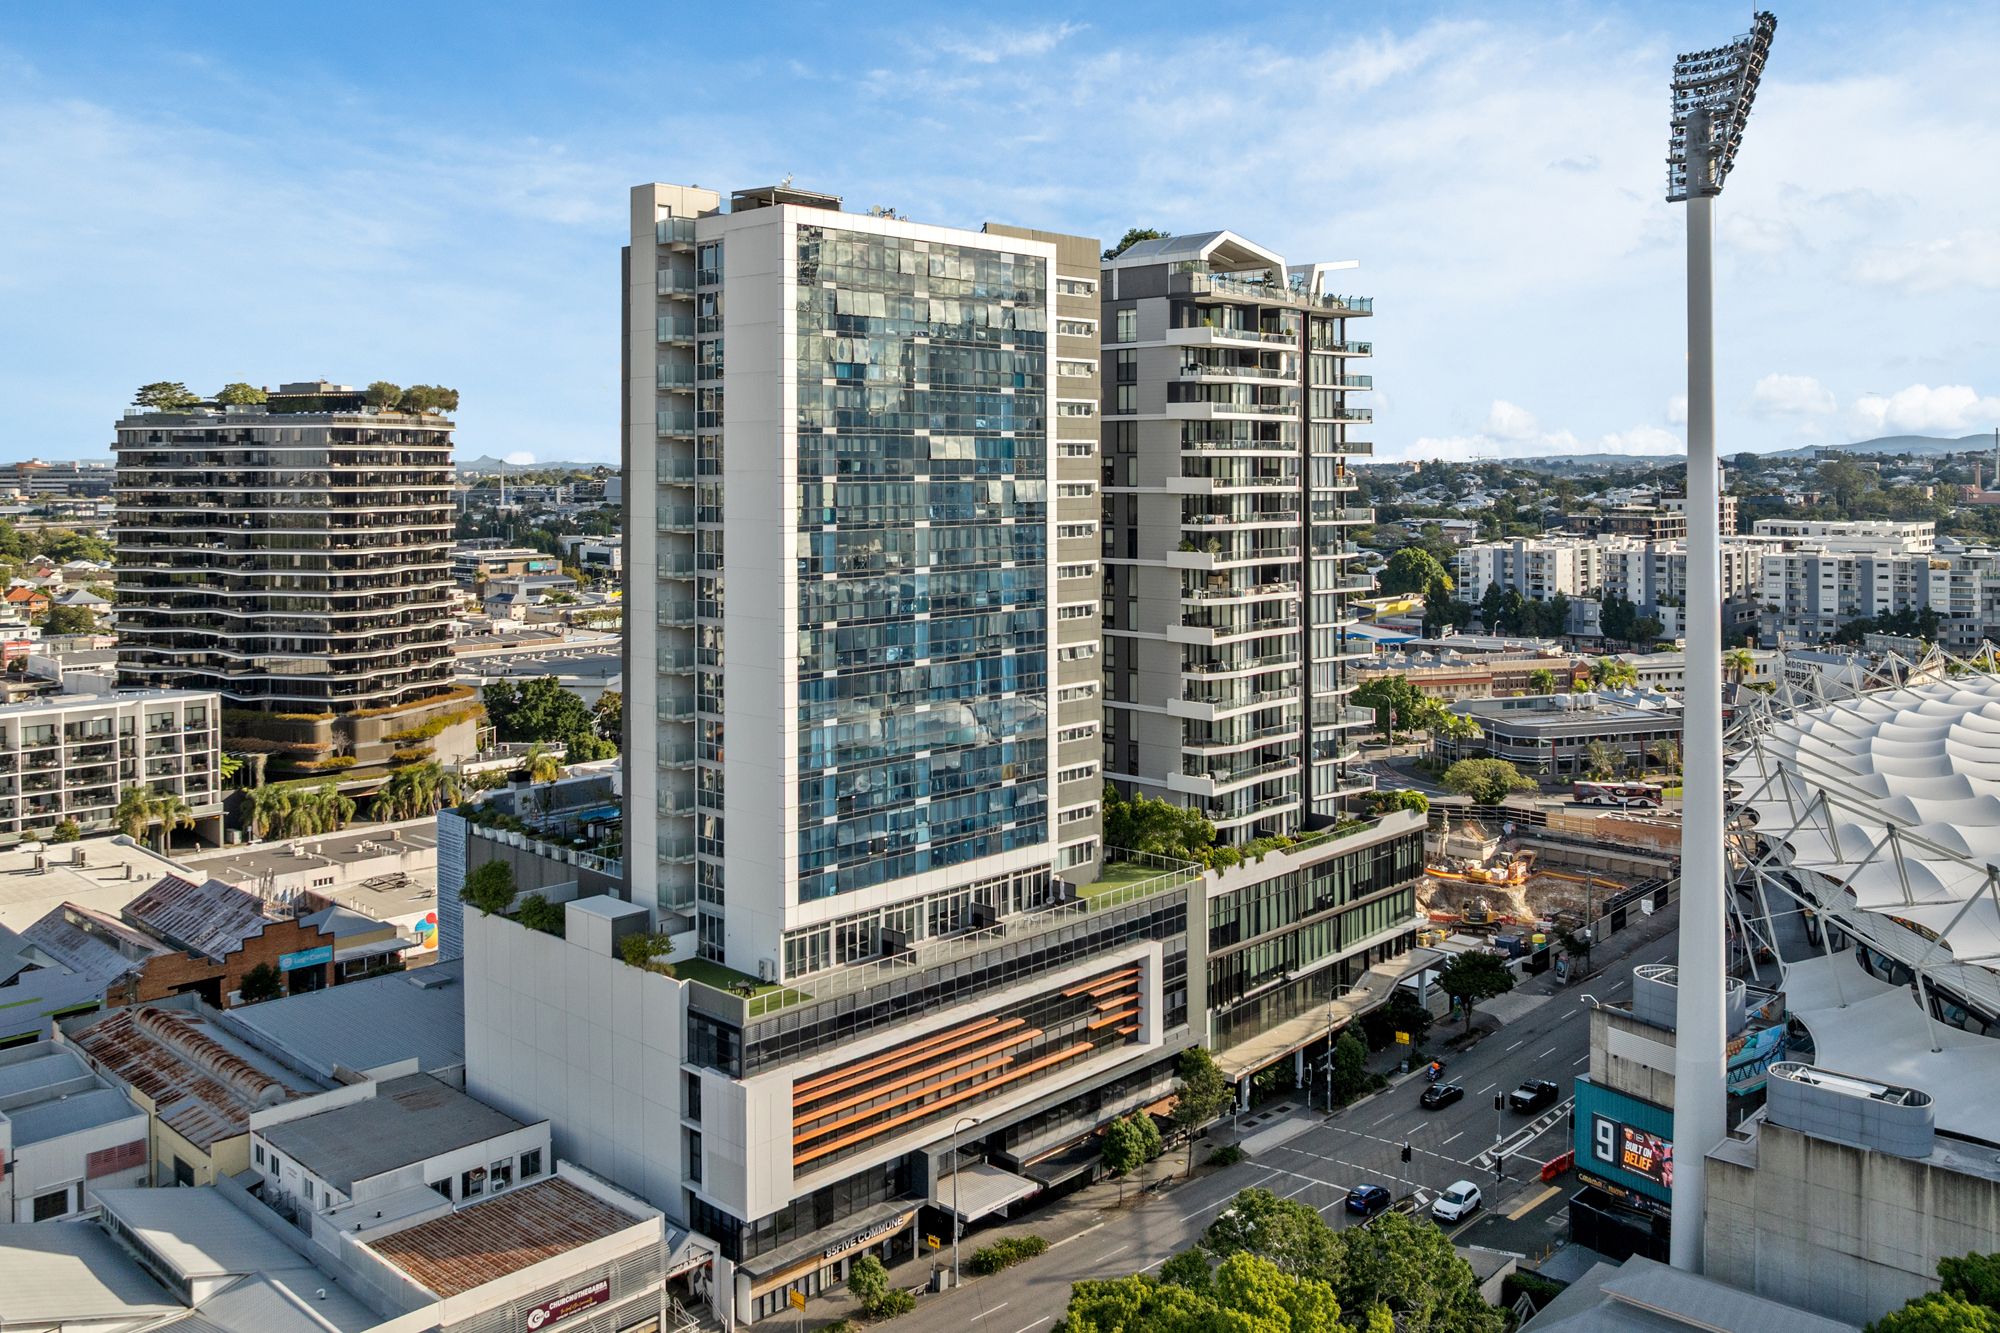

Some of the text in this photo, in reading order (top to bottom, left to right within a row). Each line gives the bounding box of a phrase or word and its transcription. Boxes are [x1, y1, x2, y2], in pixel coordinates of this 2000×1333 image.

[1596, 1118, 1614, 1162] 9
[1625, 1140, 1653, 1159] BUILT ON
[1624, 1151, 1653, 1171] BELIEF
[826, 1216, 904, 1258] 85FIVE COMMUNE
